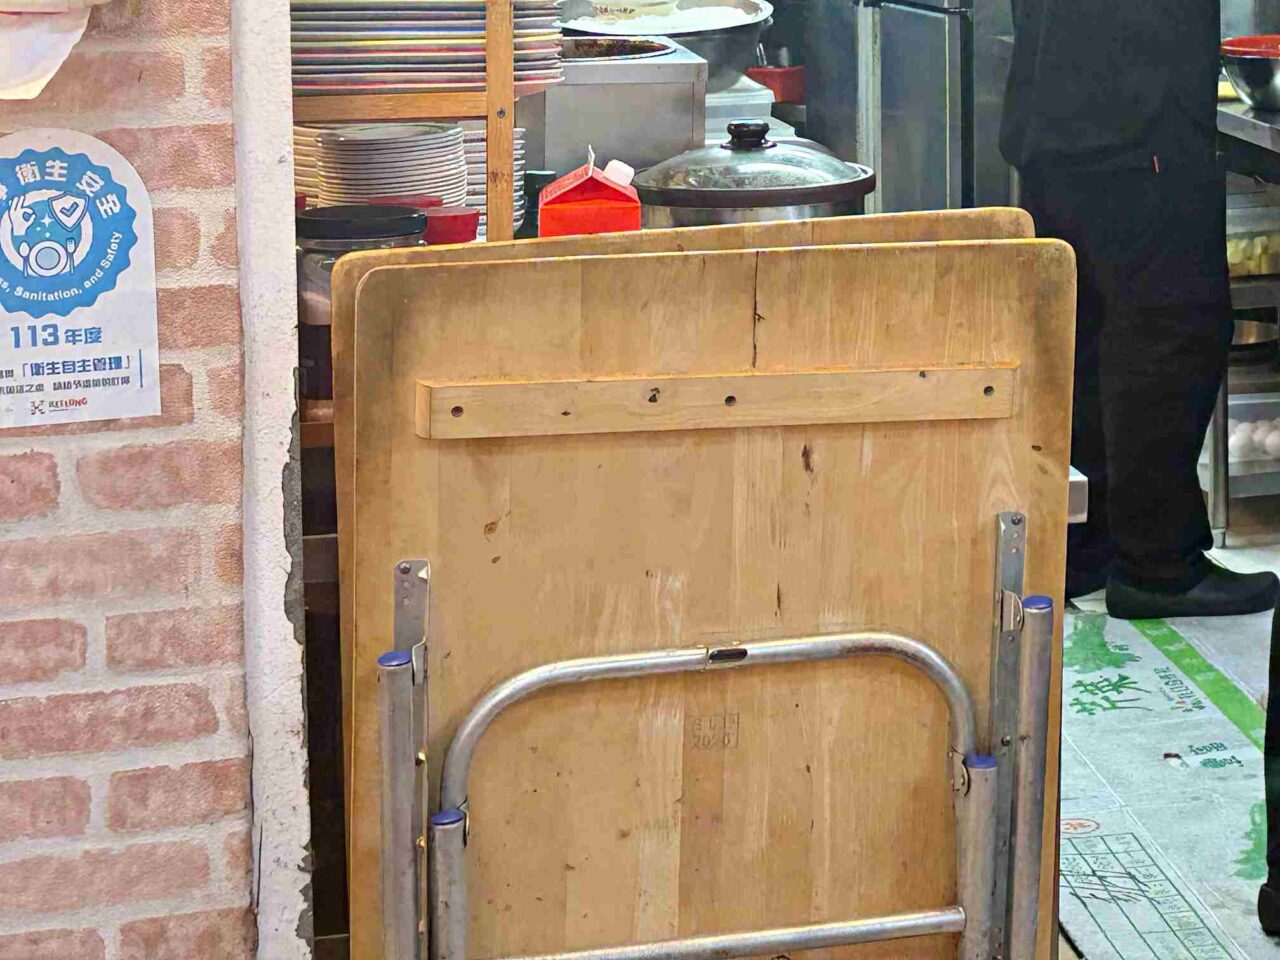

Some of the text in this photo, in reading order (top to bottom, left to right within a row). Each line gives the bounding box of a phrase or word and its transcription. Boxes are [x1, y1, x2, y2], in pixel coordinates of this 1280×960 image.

[0, 158, 122, 220] 衛生安全
[83, 269, 104, 289] and
[100, 230, 123, 269] Safety
